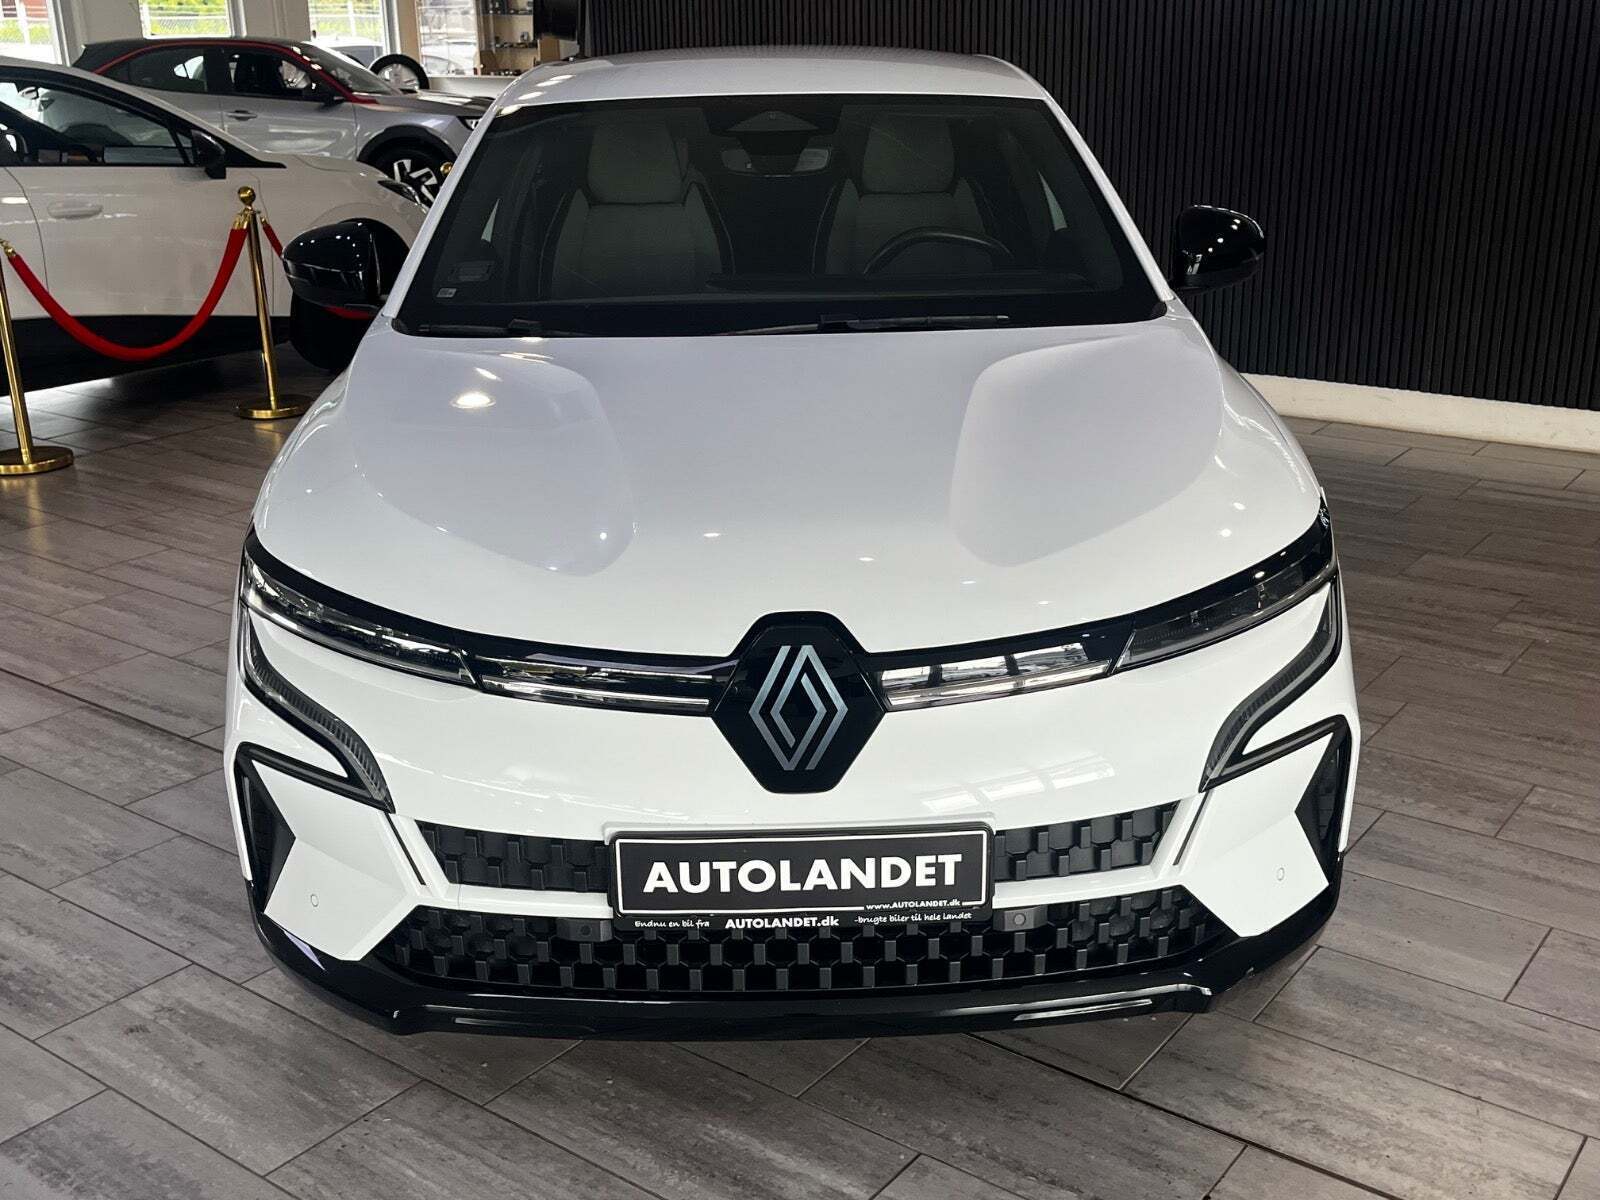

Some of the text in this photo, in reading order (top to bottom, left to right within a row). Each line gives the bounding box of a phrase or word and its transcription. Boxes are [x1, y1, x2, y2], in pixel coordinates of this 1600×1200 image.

[643, 853, 963, 894] AUTOLANDET
[866, 899, 961, 910] www.AUTOLANDET.dk
[634, 919, 666, 928] Endnu
[668, 920, 680, 928] en
[681, 919, 695, 928] bil
[695, 919, 710, 929] fra
[725, 916, 839, 929] AUTOLANDET.dk
[889, 914, 909, 922] biler
[910, 913, 922, 922] til
[924, 913, 941, 921] hele
[943, 912, 972, 920] landet
